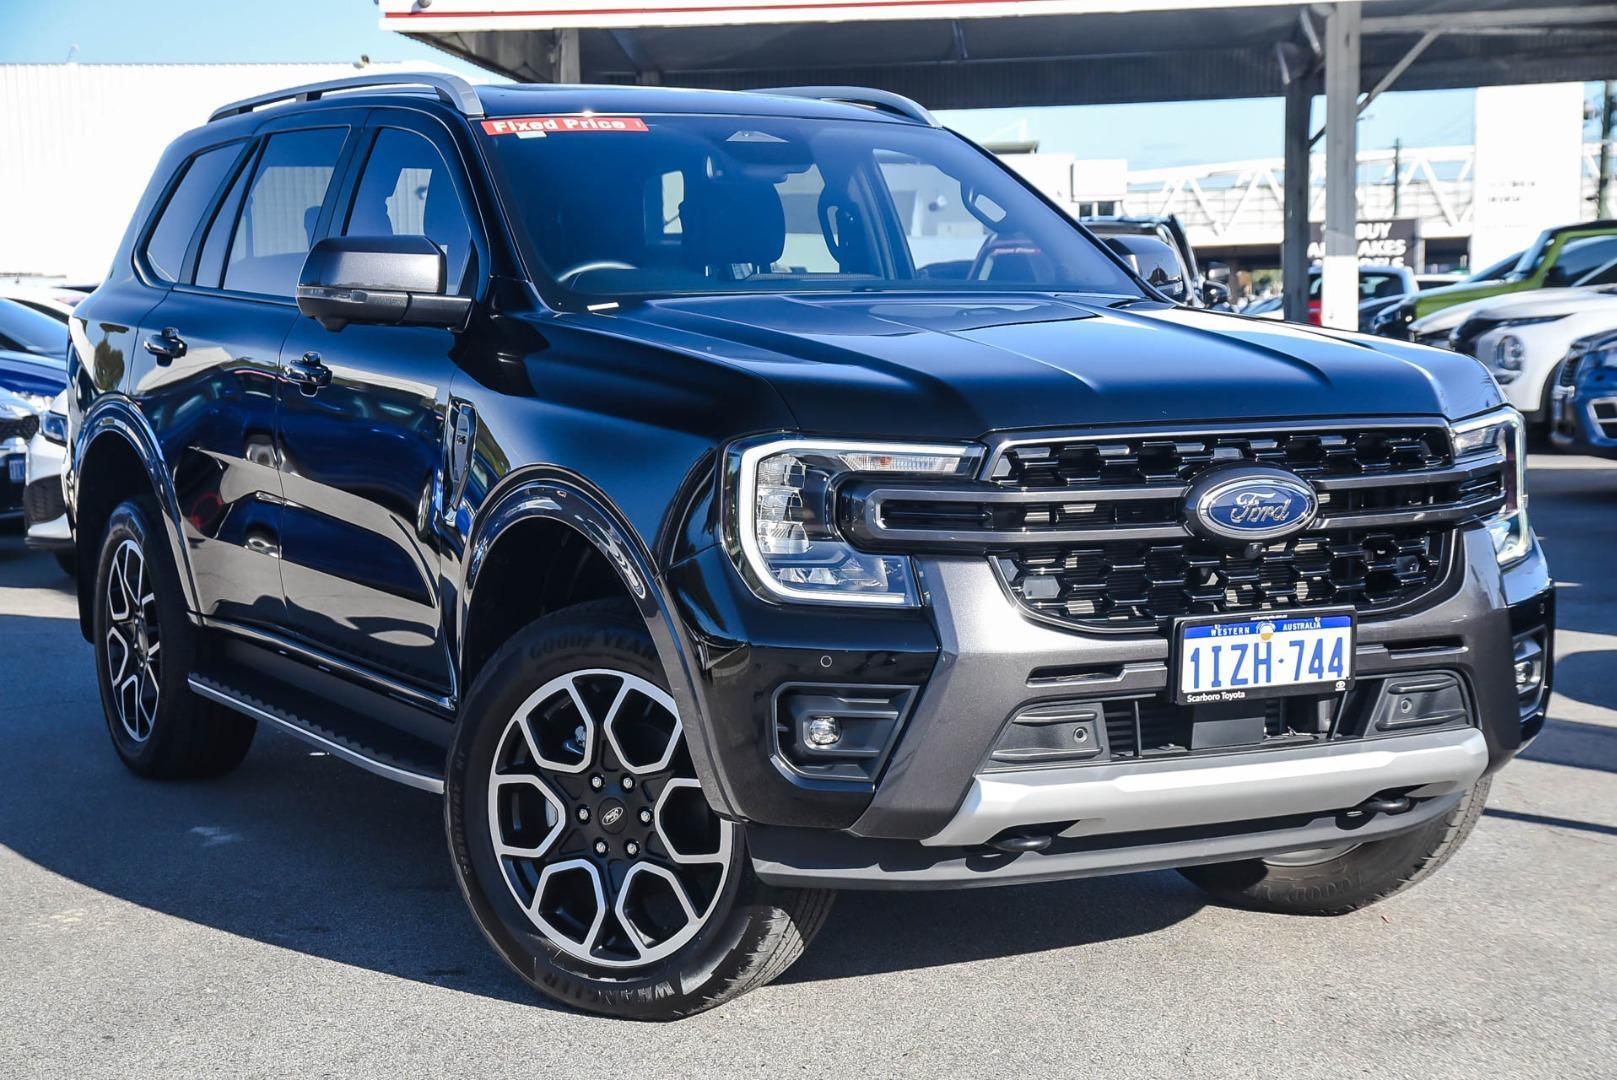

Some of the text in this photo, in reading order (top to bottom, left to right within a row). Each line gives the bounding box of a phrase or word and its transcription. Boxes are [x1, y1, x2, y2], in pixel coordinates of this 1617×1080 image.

[492, 118, 627, 133] Fixed Price
[1357, 239, 1407, 257] AKES
[1230, 492, 1292, 524] Ford
[1210, 619, 1322, 637] WESTERN AUSTRALIA
[1187, 690, 1246, 703] Scarboro Toyota
